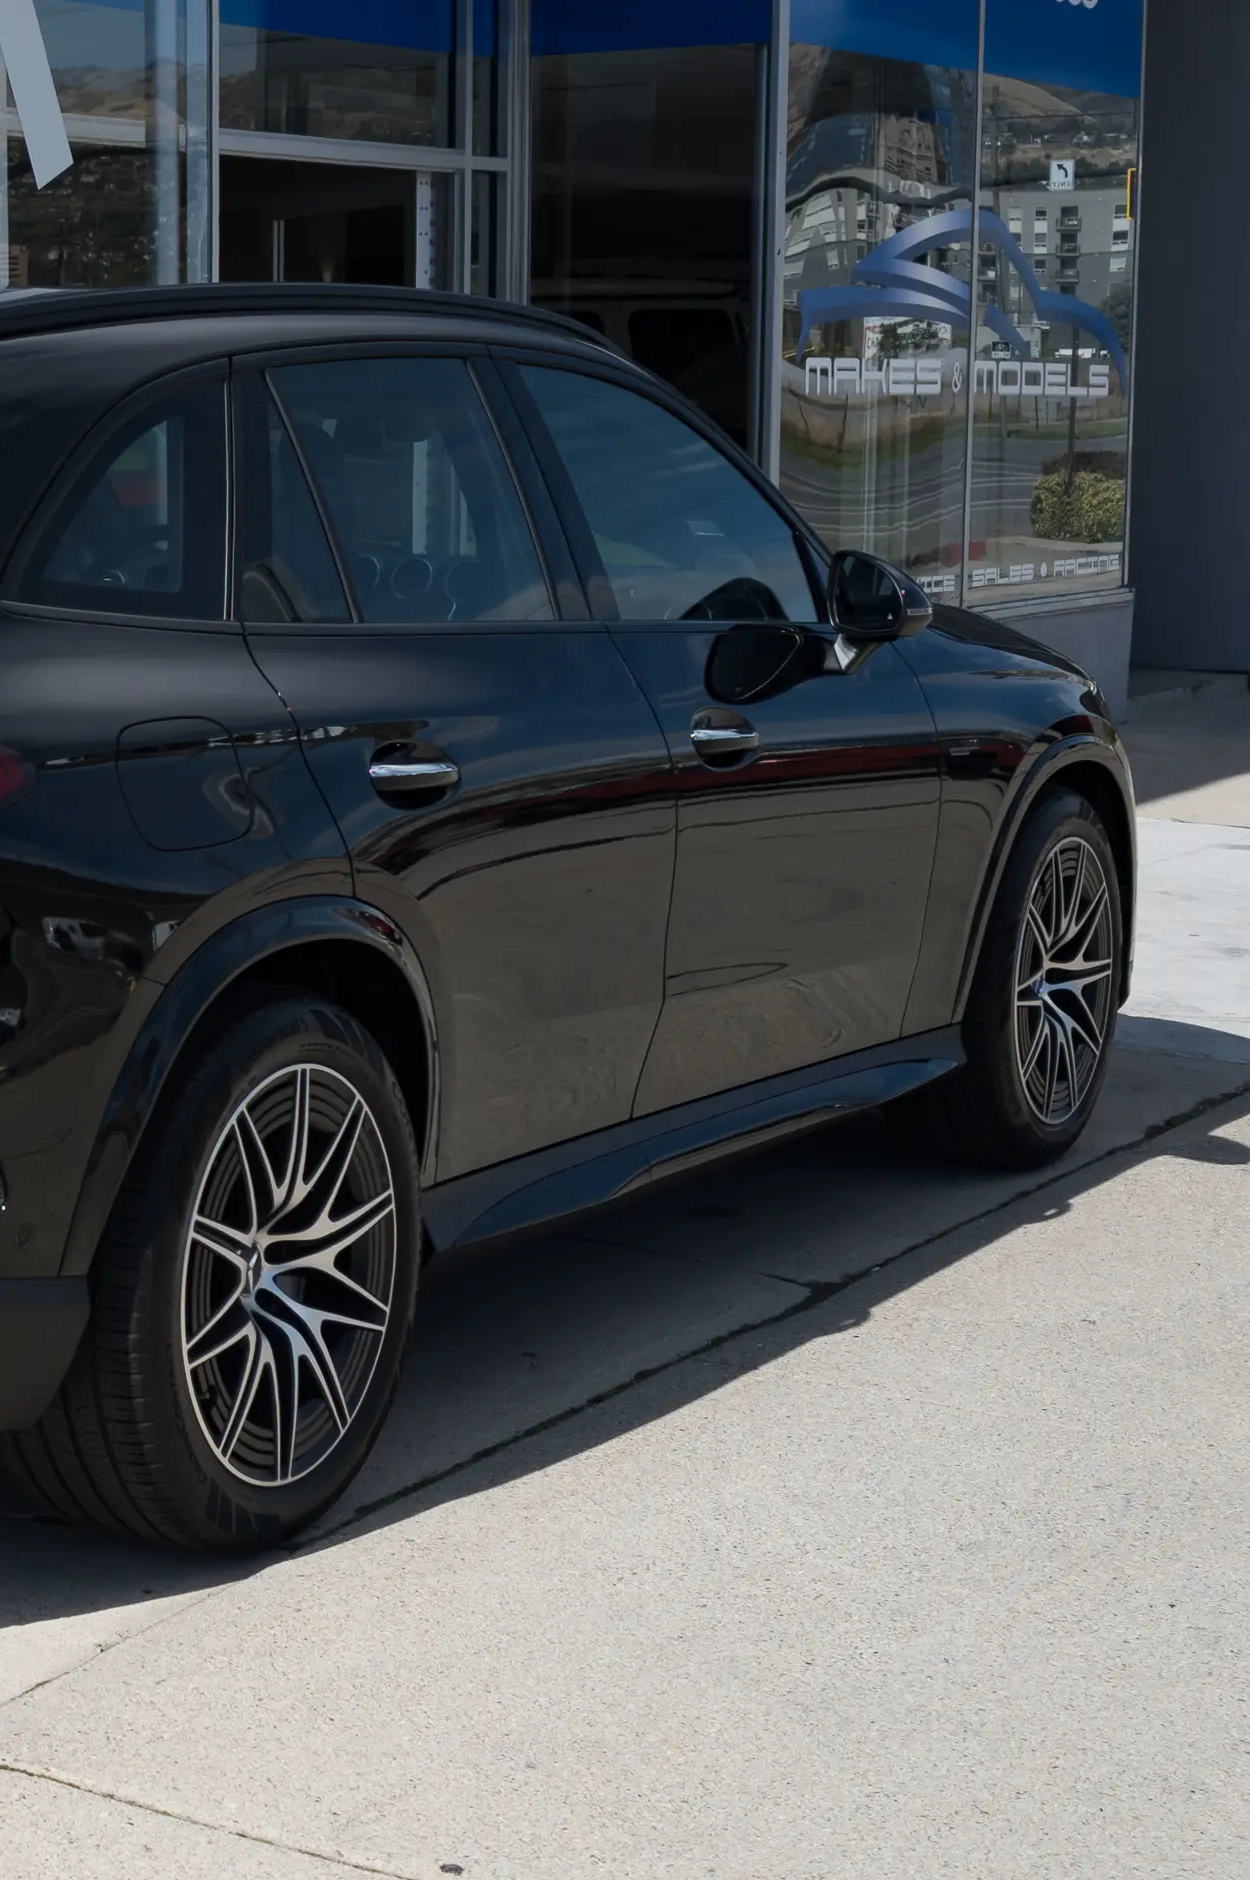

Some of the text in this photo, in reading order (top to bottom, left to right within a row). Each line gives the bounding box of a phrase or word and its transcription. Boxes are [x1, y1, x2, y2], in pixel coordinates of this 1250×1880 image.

[805, 357, 1110, 396] MAKES & MODELS
[972, 563, 1034, 587] SALES
[1053, 554, 1120, 577] RACING
